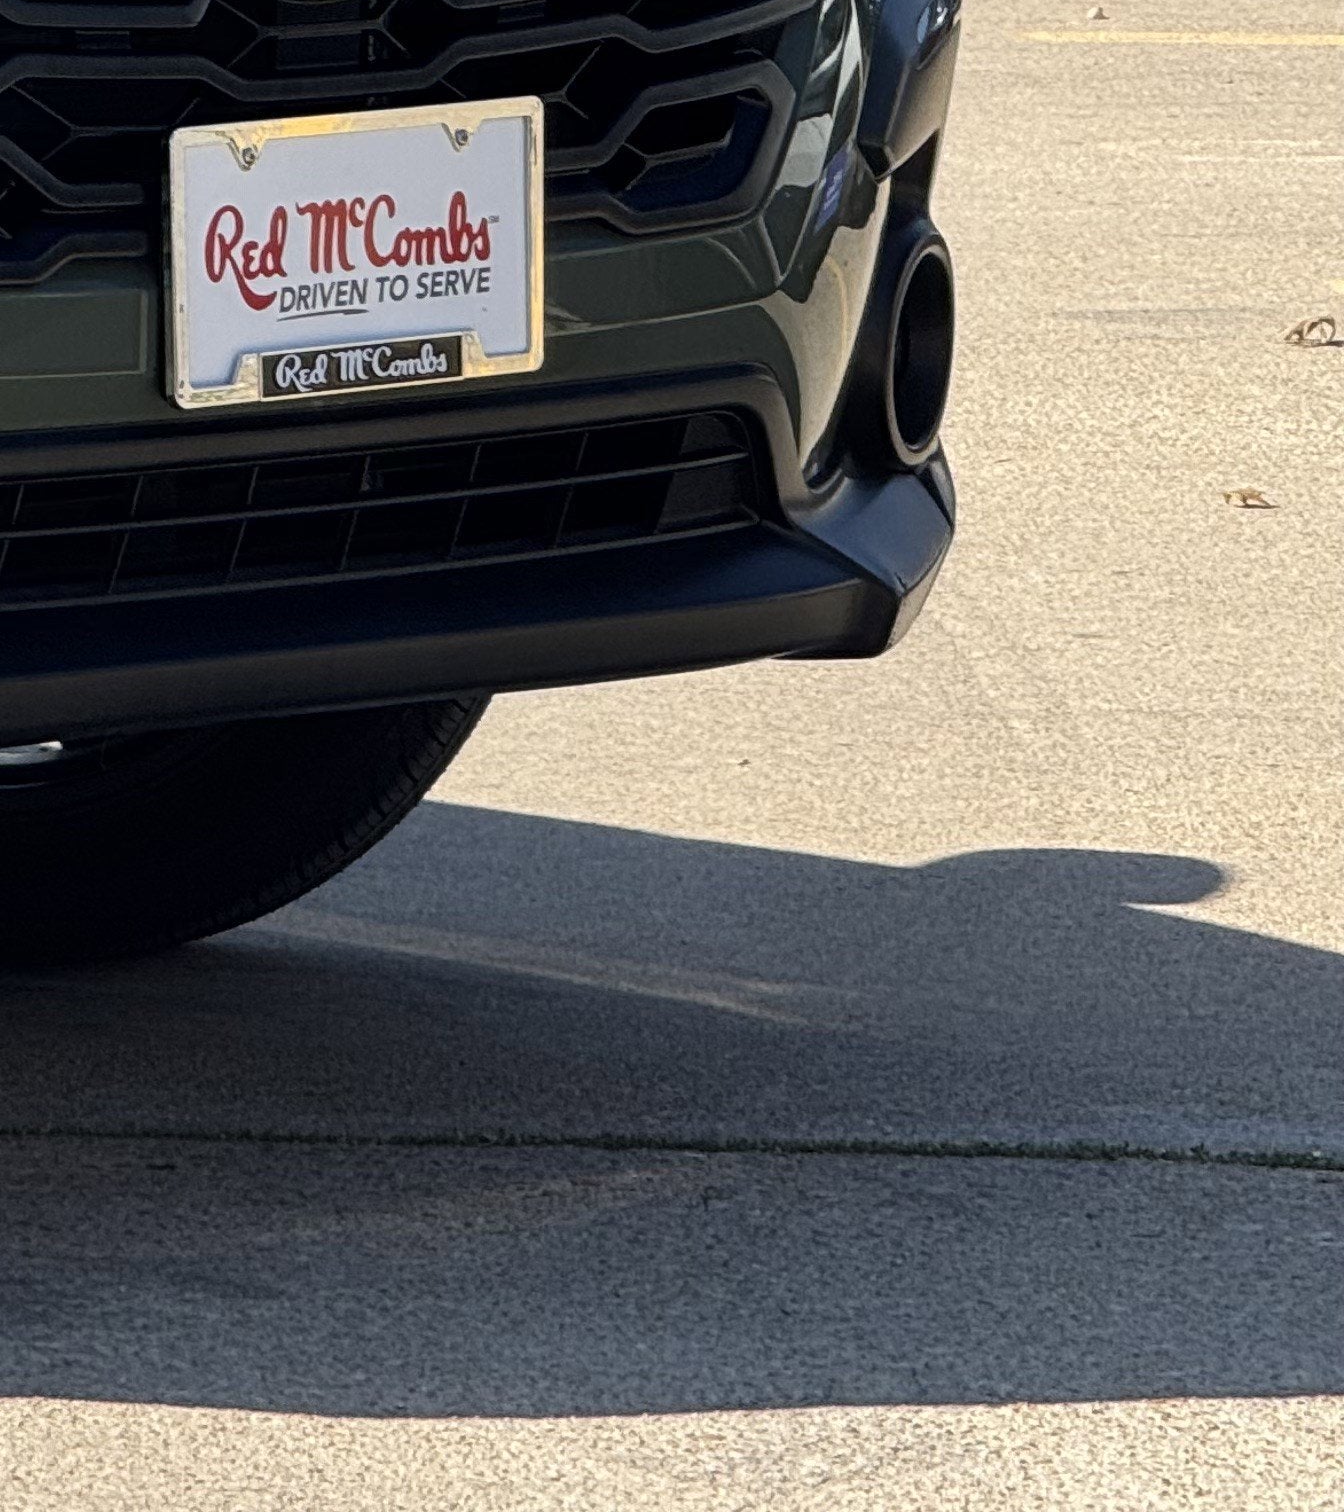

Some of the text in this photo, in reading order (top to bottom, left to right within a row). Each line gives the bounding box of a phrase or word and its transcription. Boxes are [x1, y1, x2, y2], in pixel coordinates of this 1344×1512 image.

[205, 204, 288, 311] Red
[295, 191, 491, 274] McCombs
[279, 267, 491, 313] DRIVEN TO SERVE
[276, 343, 448, 392] Red McCombs
